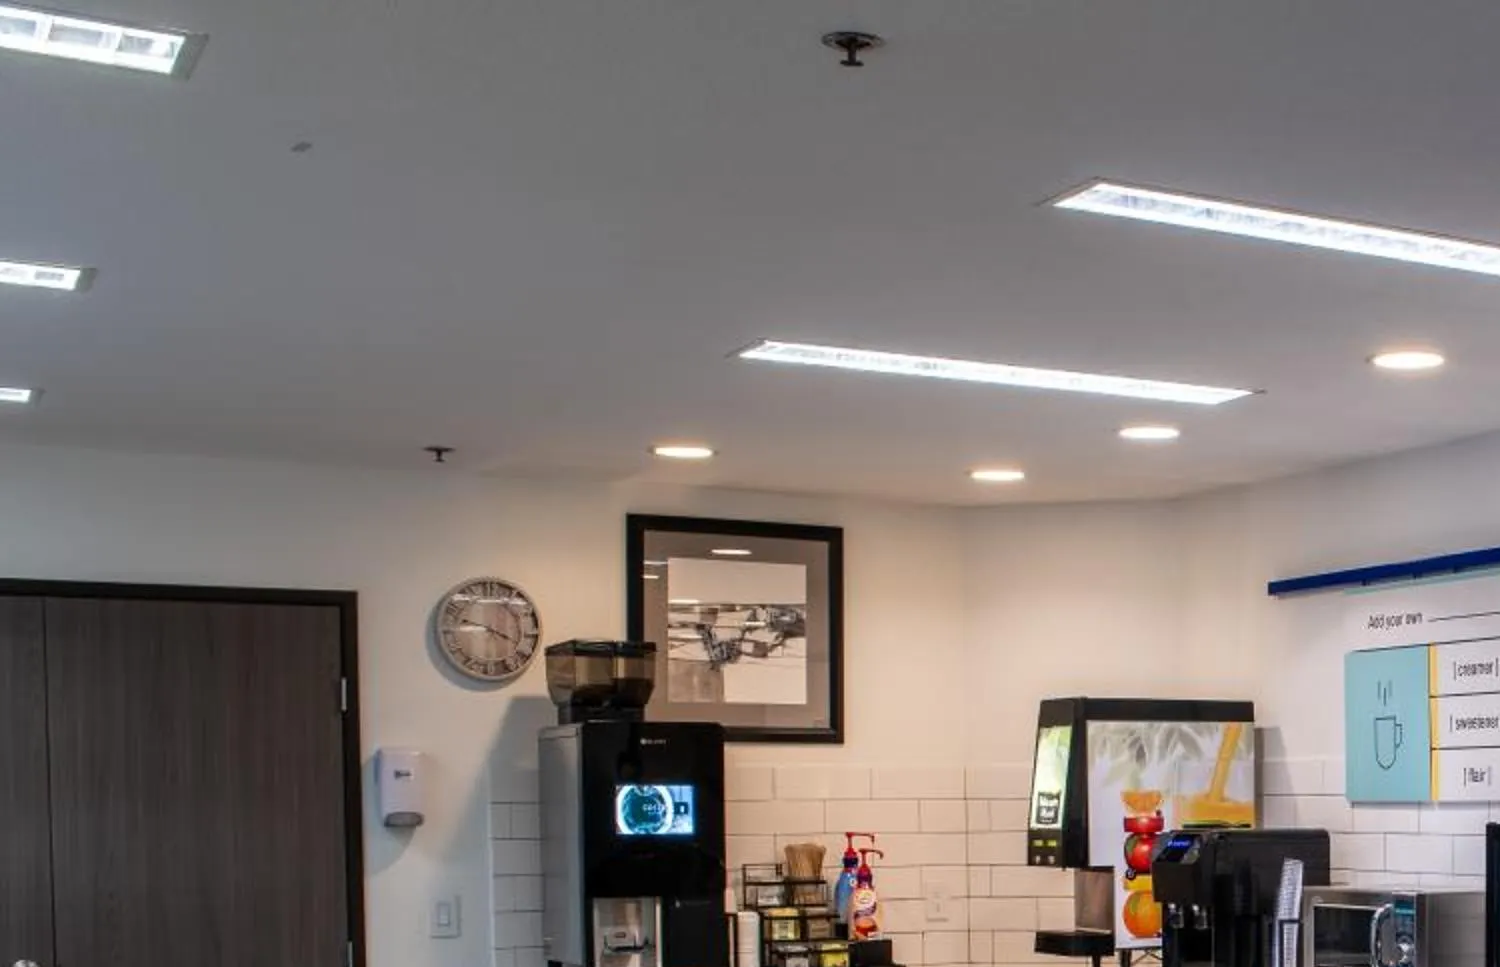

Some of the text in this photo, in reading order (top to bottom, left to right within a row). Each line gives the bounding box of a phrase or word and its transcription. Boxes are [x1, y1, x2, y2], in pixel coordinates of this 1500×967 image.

[1367, 611, 1423, 631] Add your own
